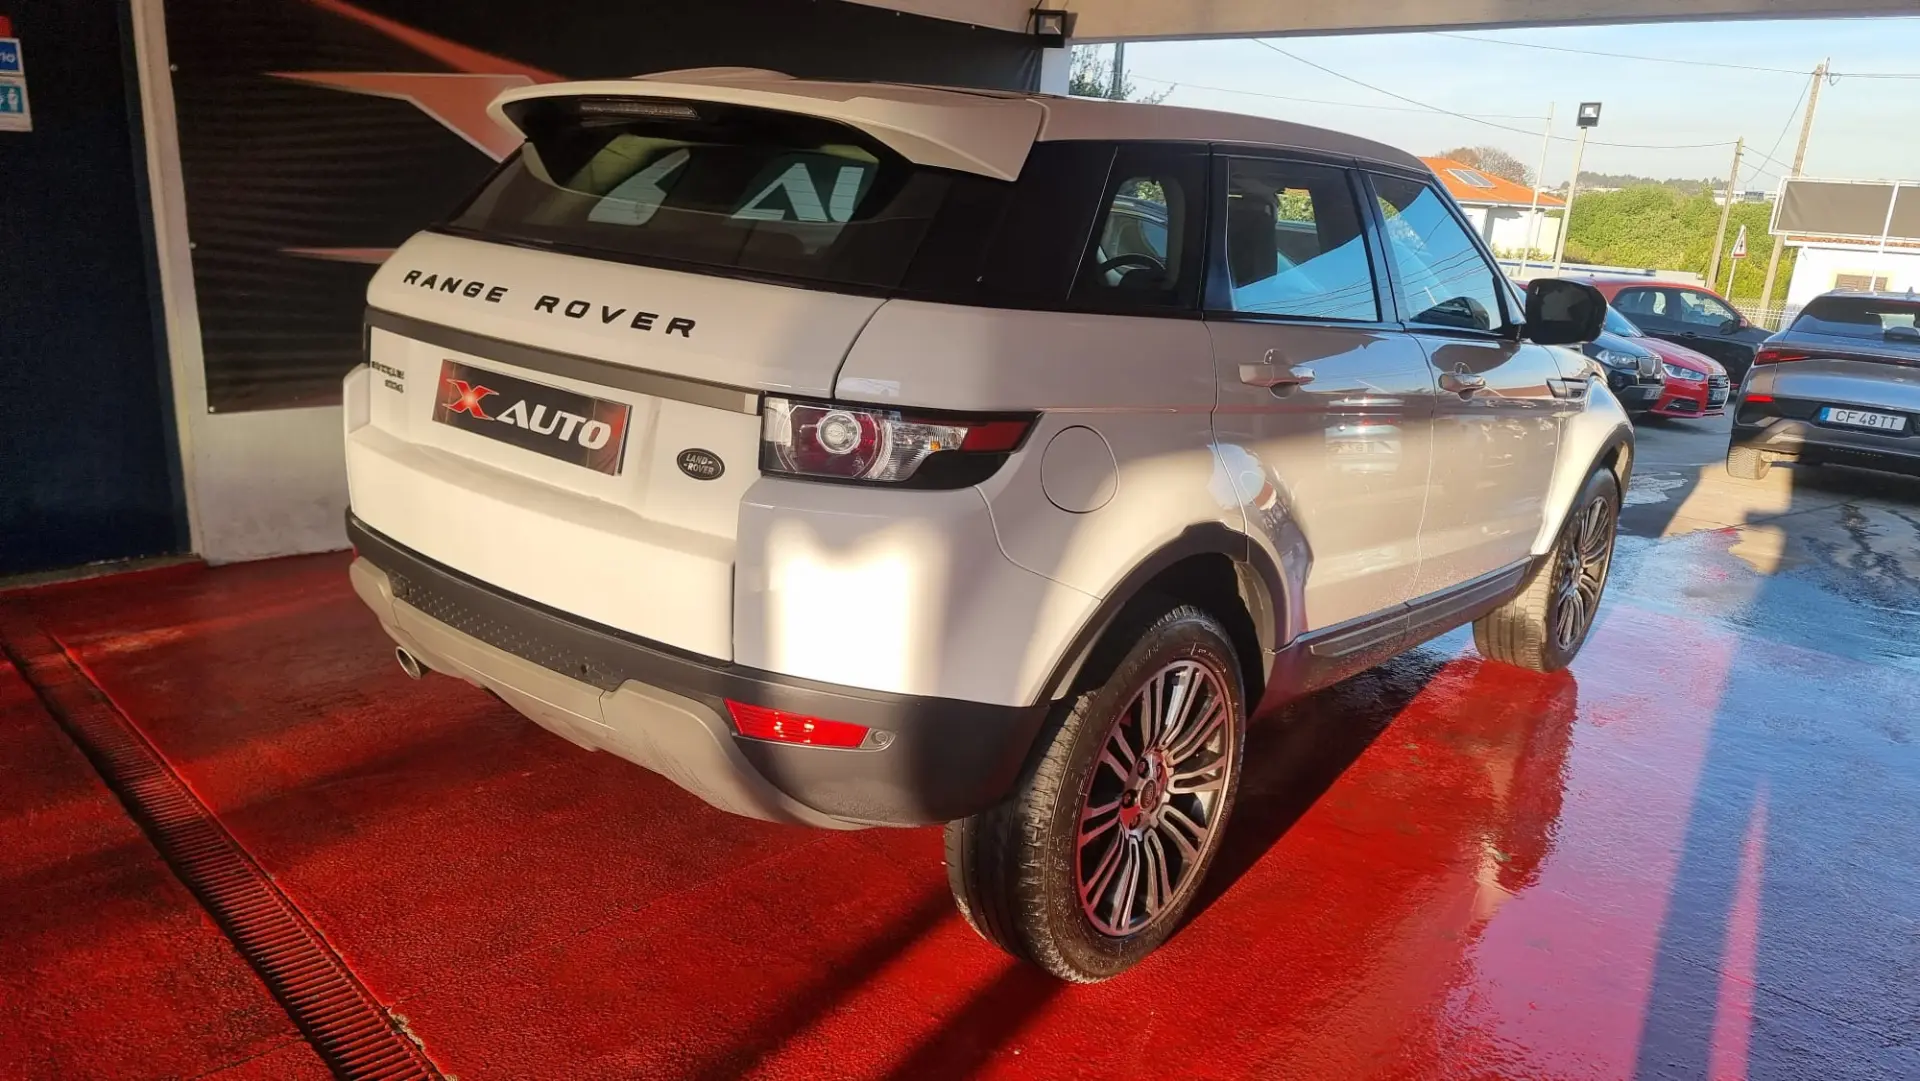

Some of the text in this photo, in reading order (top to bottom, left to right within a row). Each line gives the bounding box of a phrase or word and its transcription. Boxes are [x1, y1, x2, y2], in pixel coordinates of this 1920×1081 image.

[403, 269, 697, 338] RANGE ROVER
[442, 377, 612, 450] X AUTO
[1835, 410, 1898, 429] CF 48 TT
